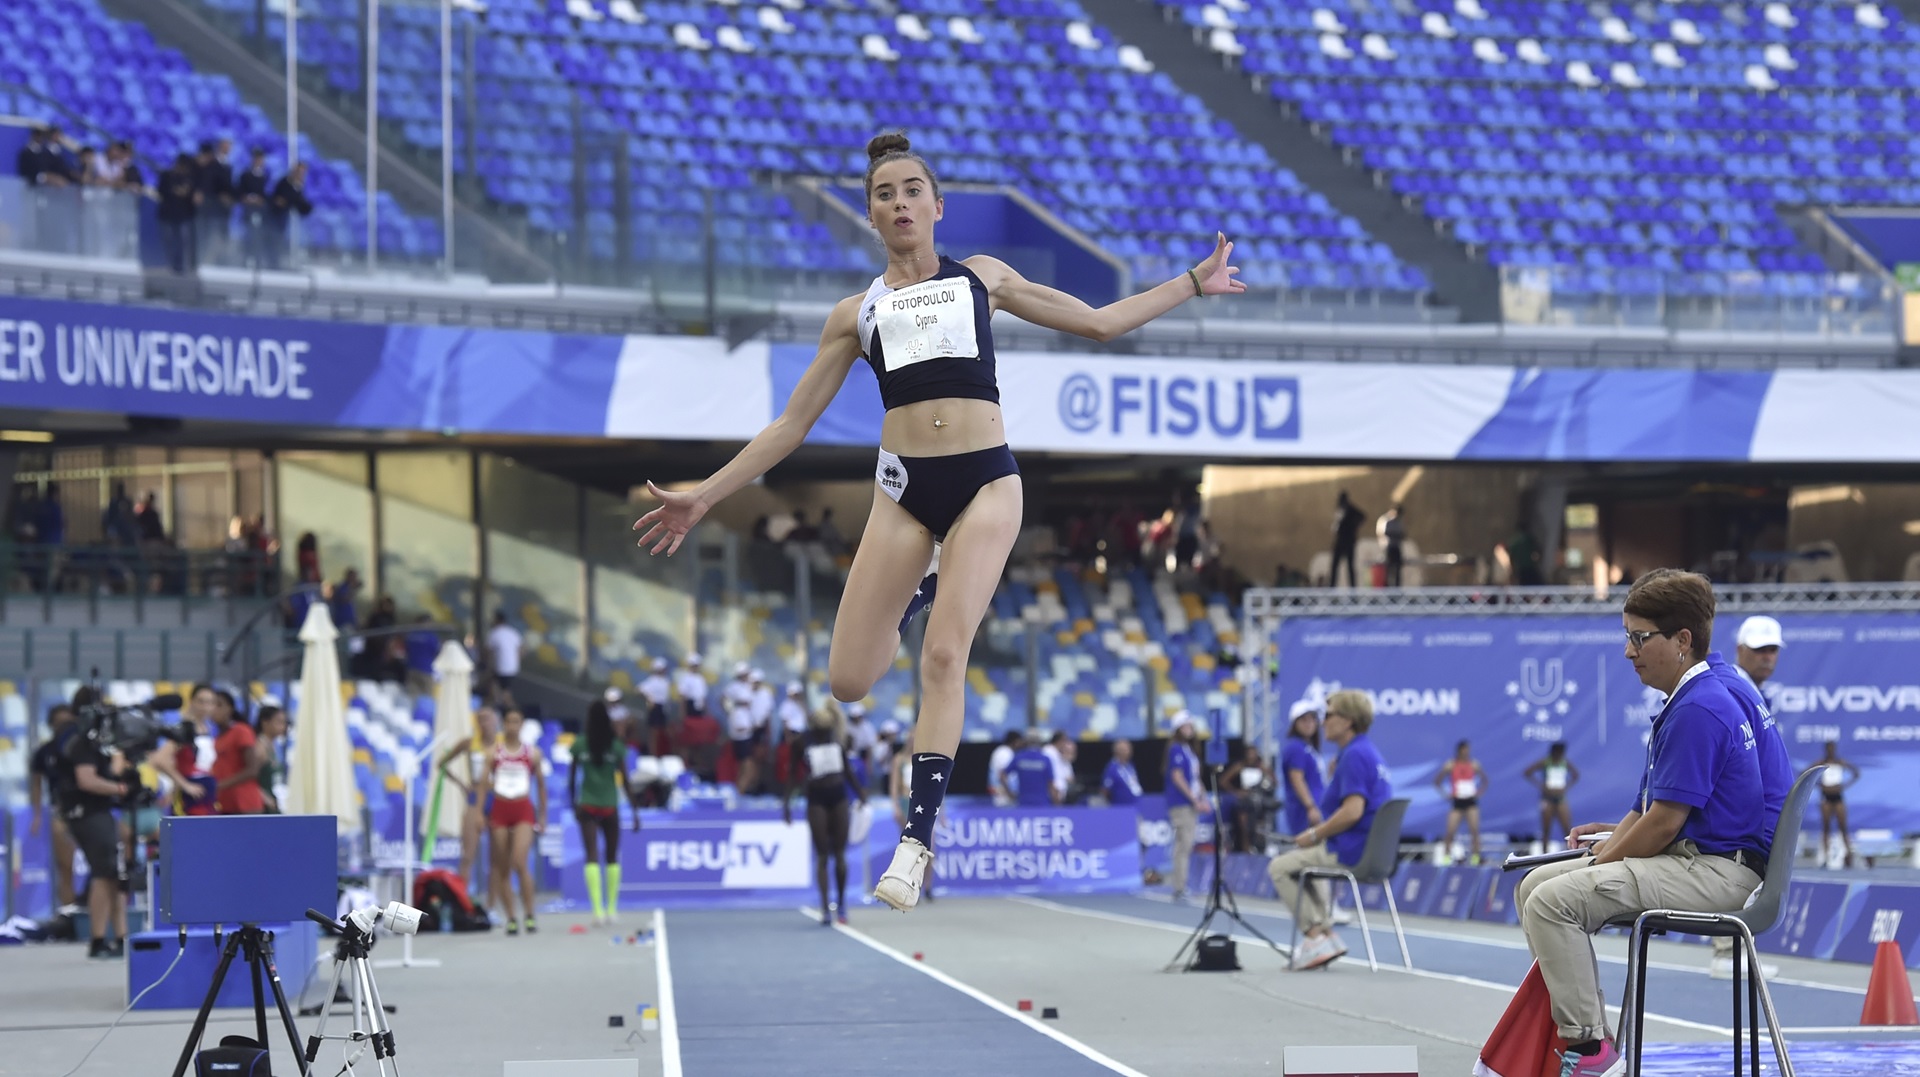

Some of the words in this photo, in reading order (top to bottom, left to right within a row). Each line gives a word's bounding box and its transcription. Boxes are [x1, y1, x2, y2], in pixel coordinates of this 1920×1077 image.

[892, 290, 955, 311] FOTOPOULOU
[915, 314, 938, 330] Cyprus
[55, 323, 313, 400] UNIVERSIADE
[1057, 371, 1247, 438] @FISU
[934, 816, 1075, 848] SUMMER
[646, 840, 781, 871] FISU.TV
[931, 849, 1111, 880] NIVERSIADE
